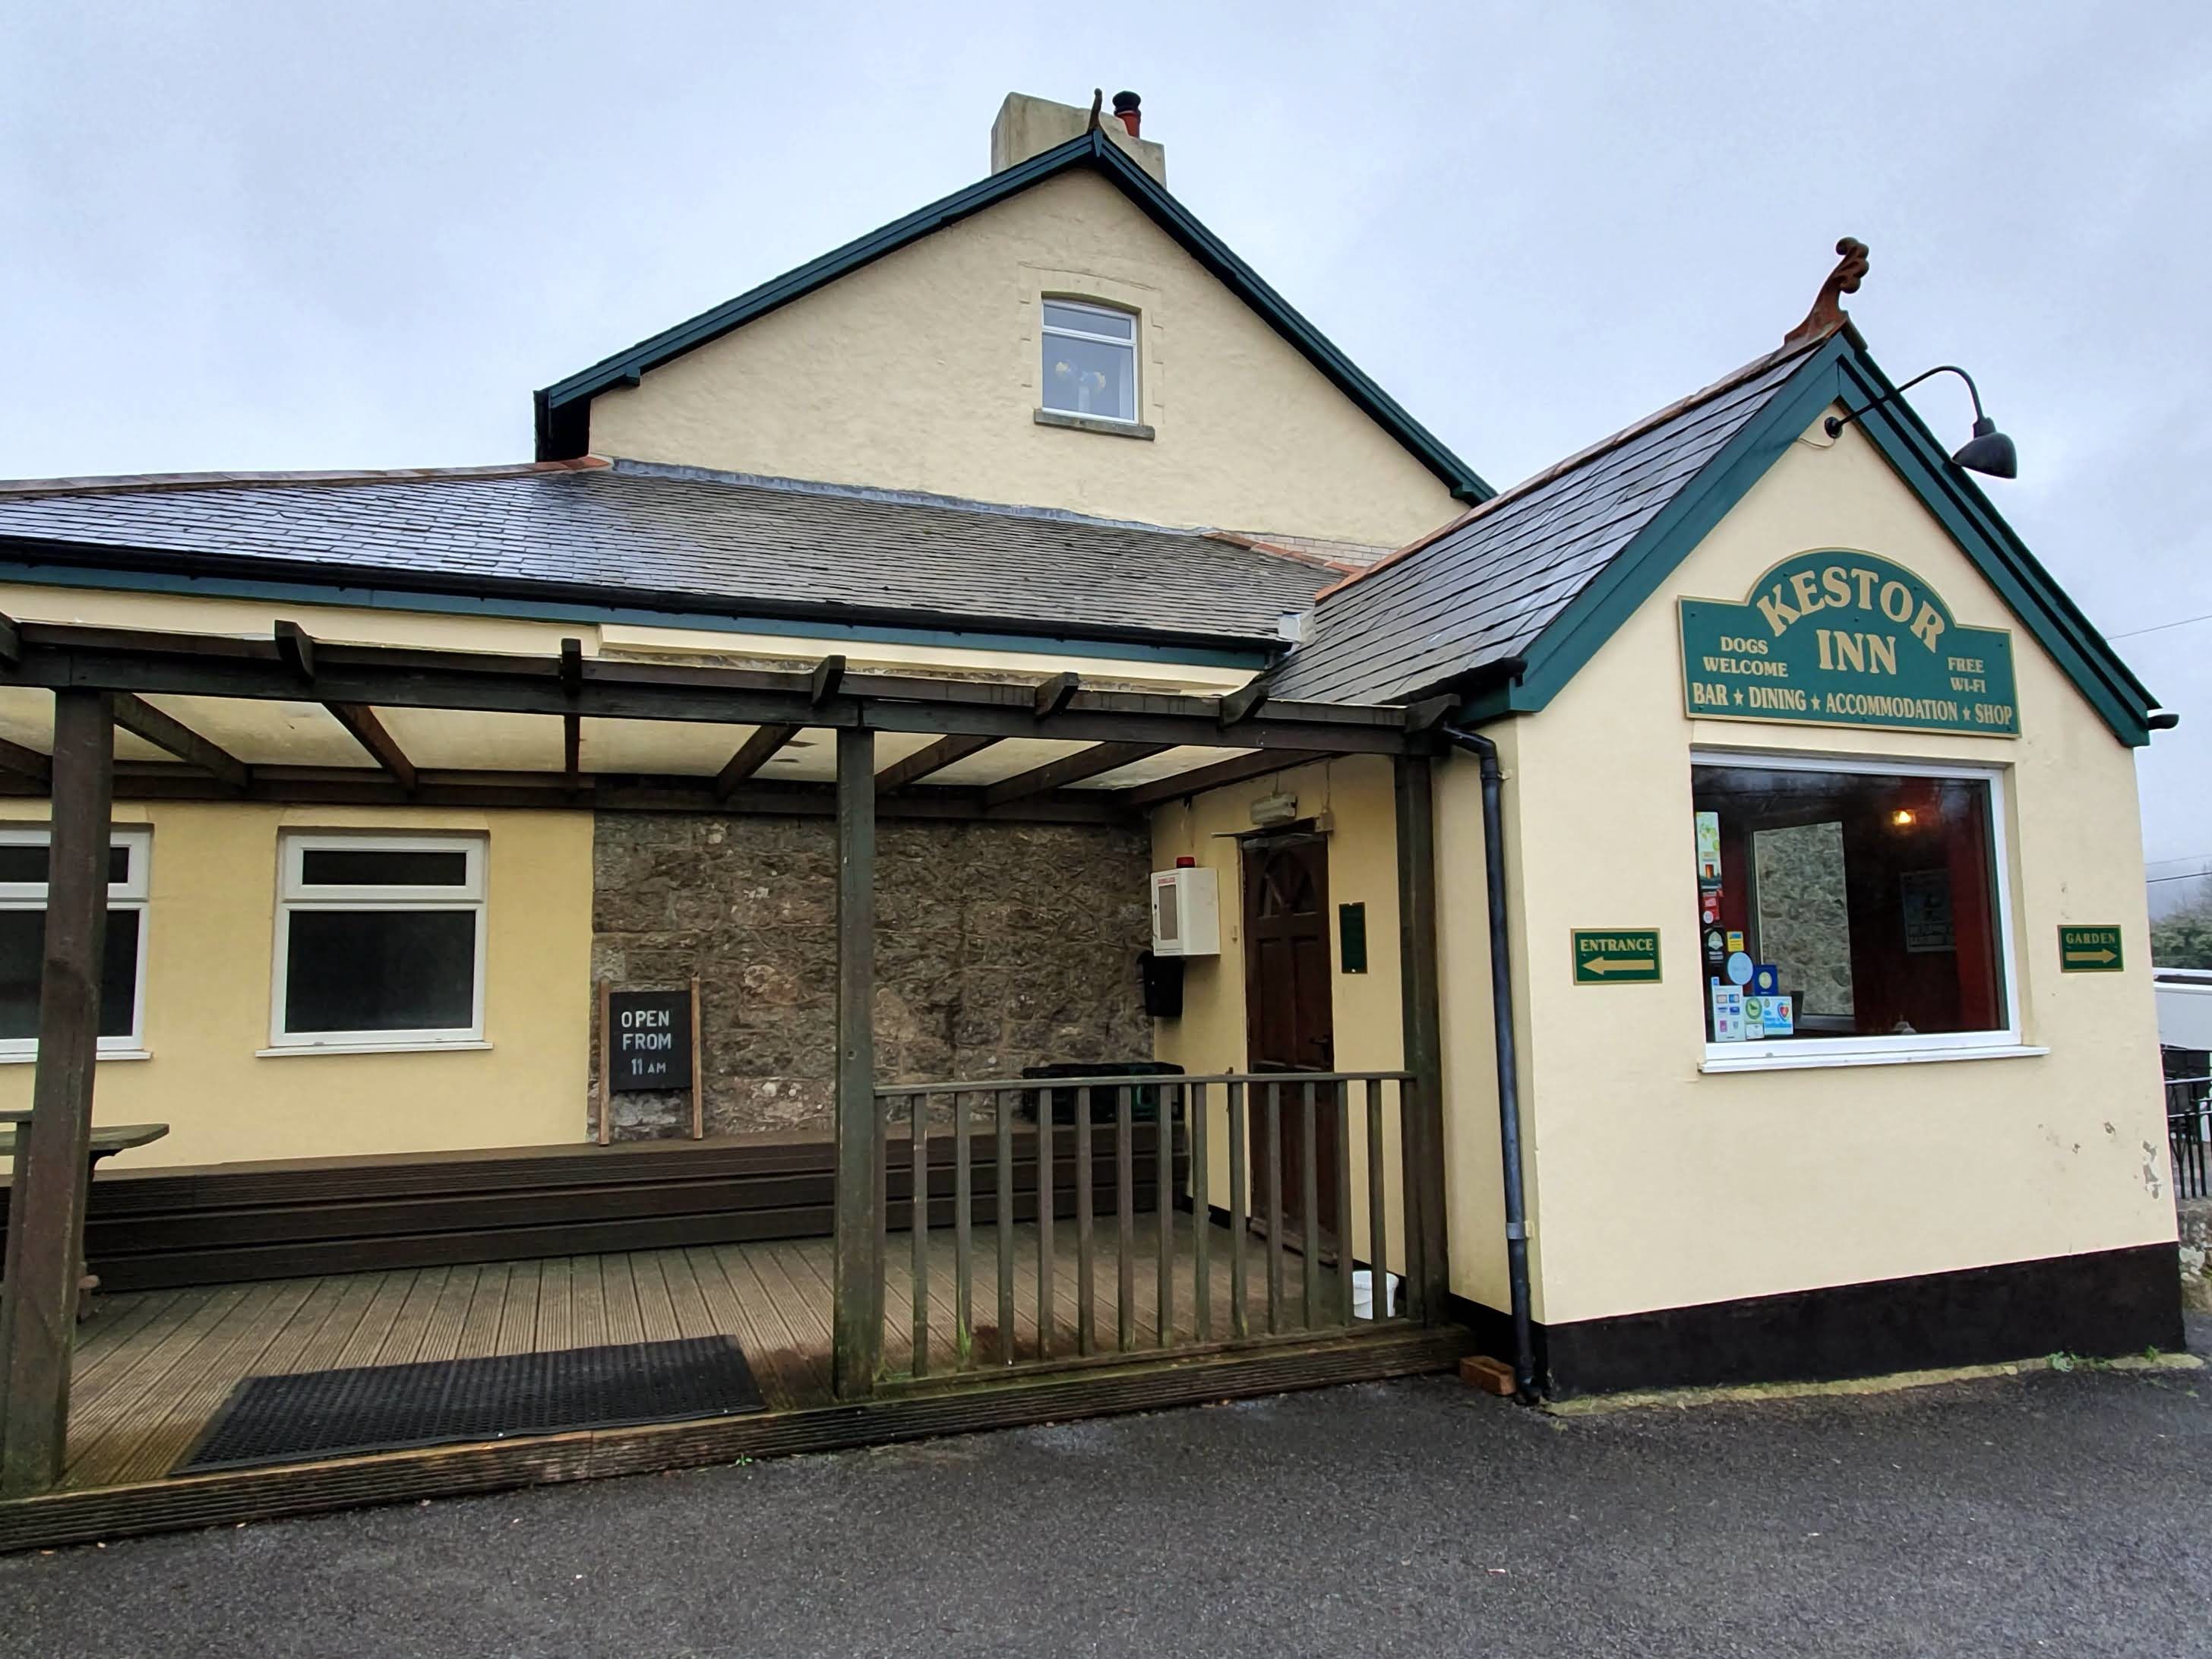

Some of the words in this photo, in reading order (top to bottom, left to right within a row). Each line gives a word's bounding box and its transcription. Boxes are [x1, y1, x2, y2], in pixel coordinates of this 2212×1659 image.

[1757, 566, 1945, 653] KESTOR
[1721, 636, 1768, 655] DOGS
[1816, 629, 1897, 675] INN
[1703, 656, 1789, 677] WELCOME
[1948, 656, 1985, 674] FREE
[1950, 677, 1986, 694] WI-FI
[1692, 682, 1729, 706] BAR
[1749, 686, 1807, 711] DINING
[1825, 692, 1958, 722] ACCOMMODATION
[1975, 703, 2013, 725] SHOP
[1581, 939, 1654, 951] ENTRANCE
[2066, 933, 2115, 943] GARDEN
[621, 1010, 669, 1028] OPEN
[622, 1032, 672, 1051] FROM
[631, 1057, 643, 1075] 11
